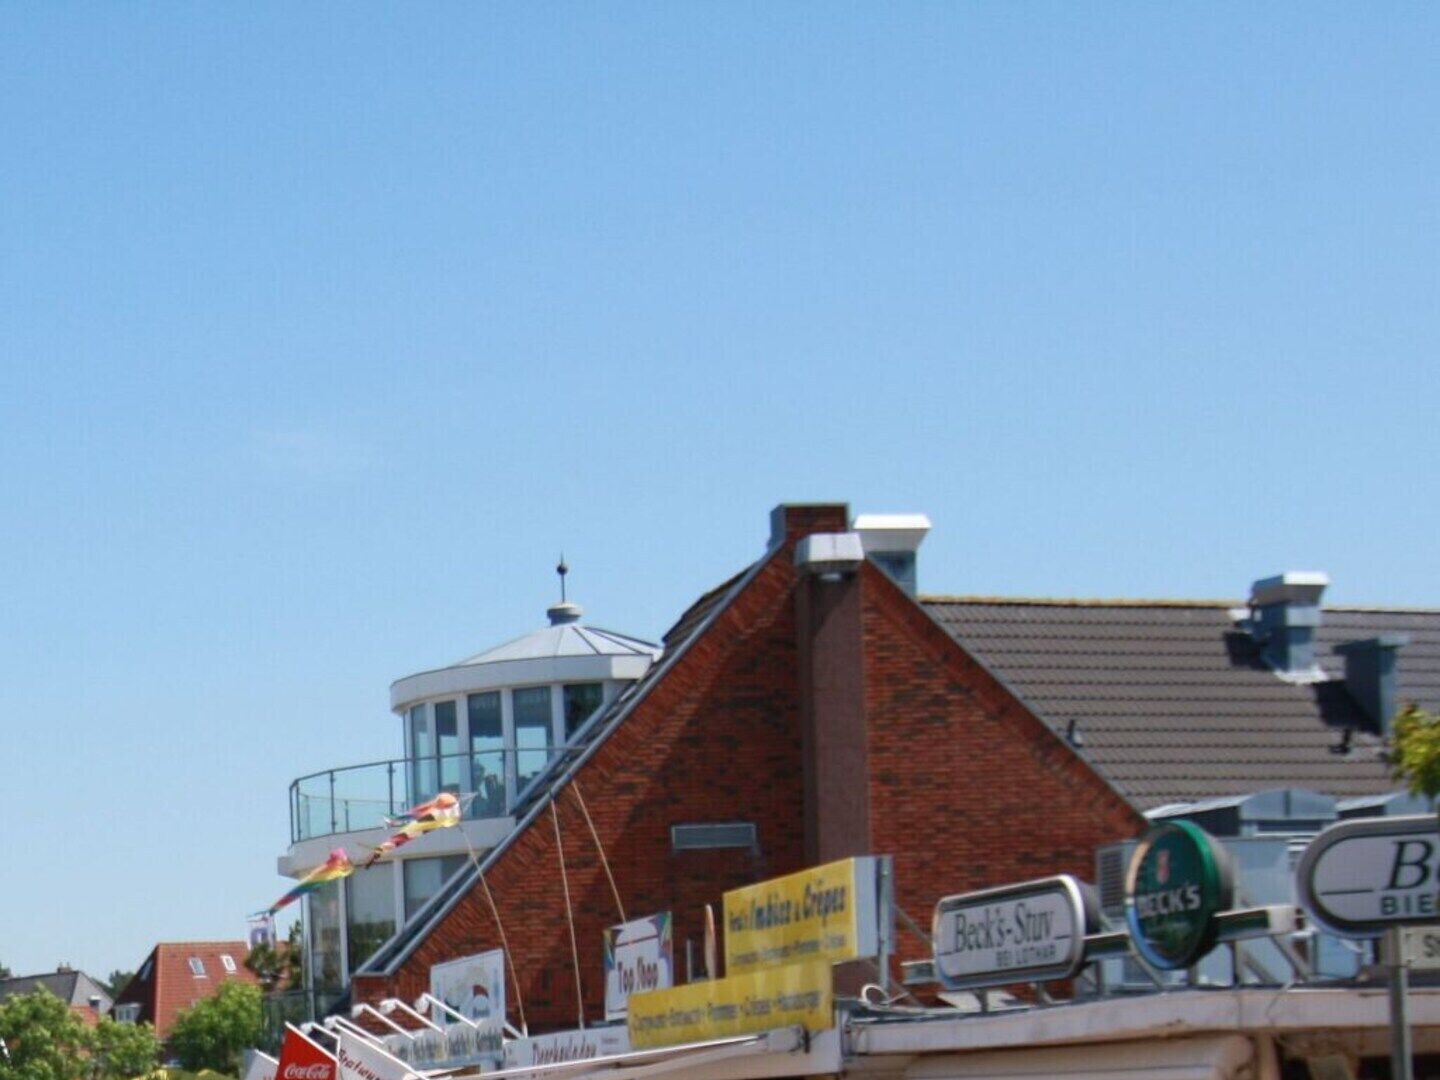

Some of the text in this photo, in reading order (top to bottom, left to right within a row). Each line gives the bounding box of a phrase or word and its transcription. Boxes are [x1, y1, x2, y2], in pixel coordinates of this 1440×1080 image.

[1381, 839, 1440, 891] B
[1134, 880, 1201, 918] BECK'S
[953, 902, 1056, 952] Beck's-Stuv
[617, 955, 659, 995] Top Shop
